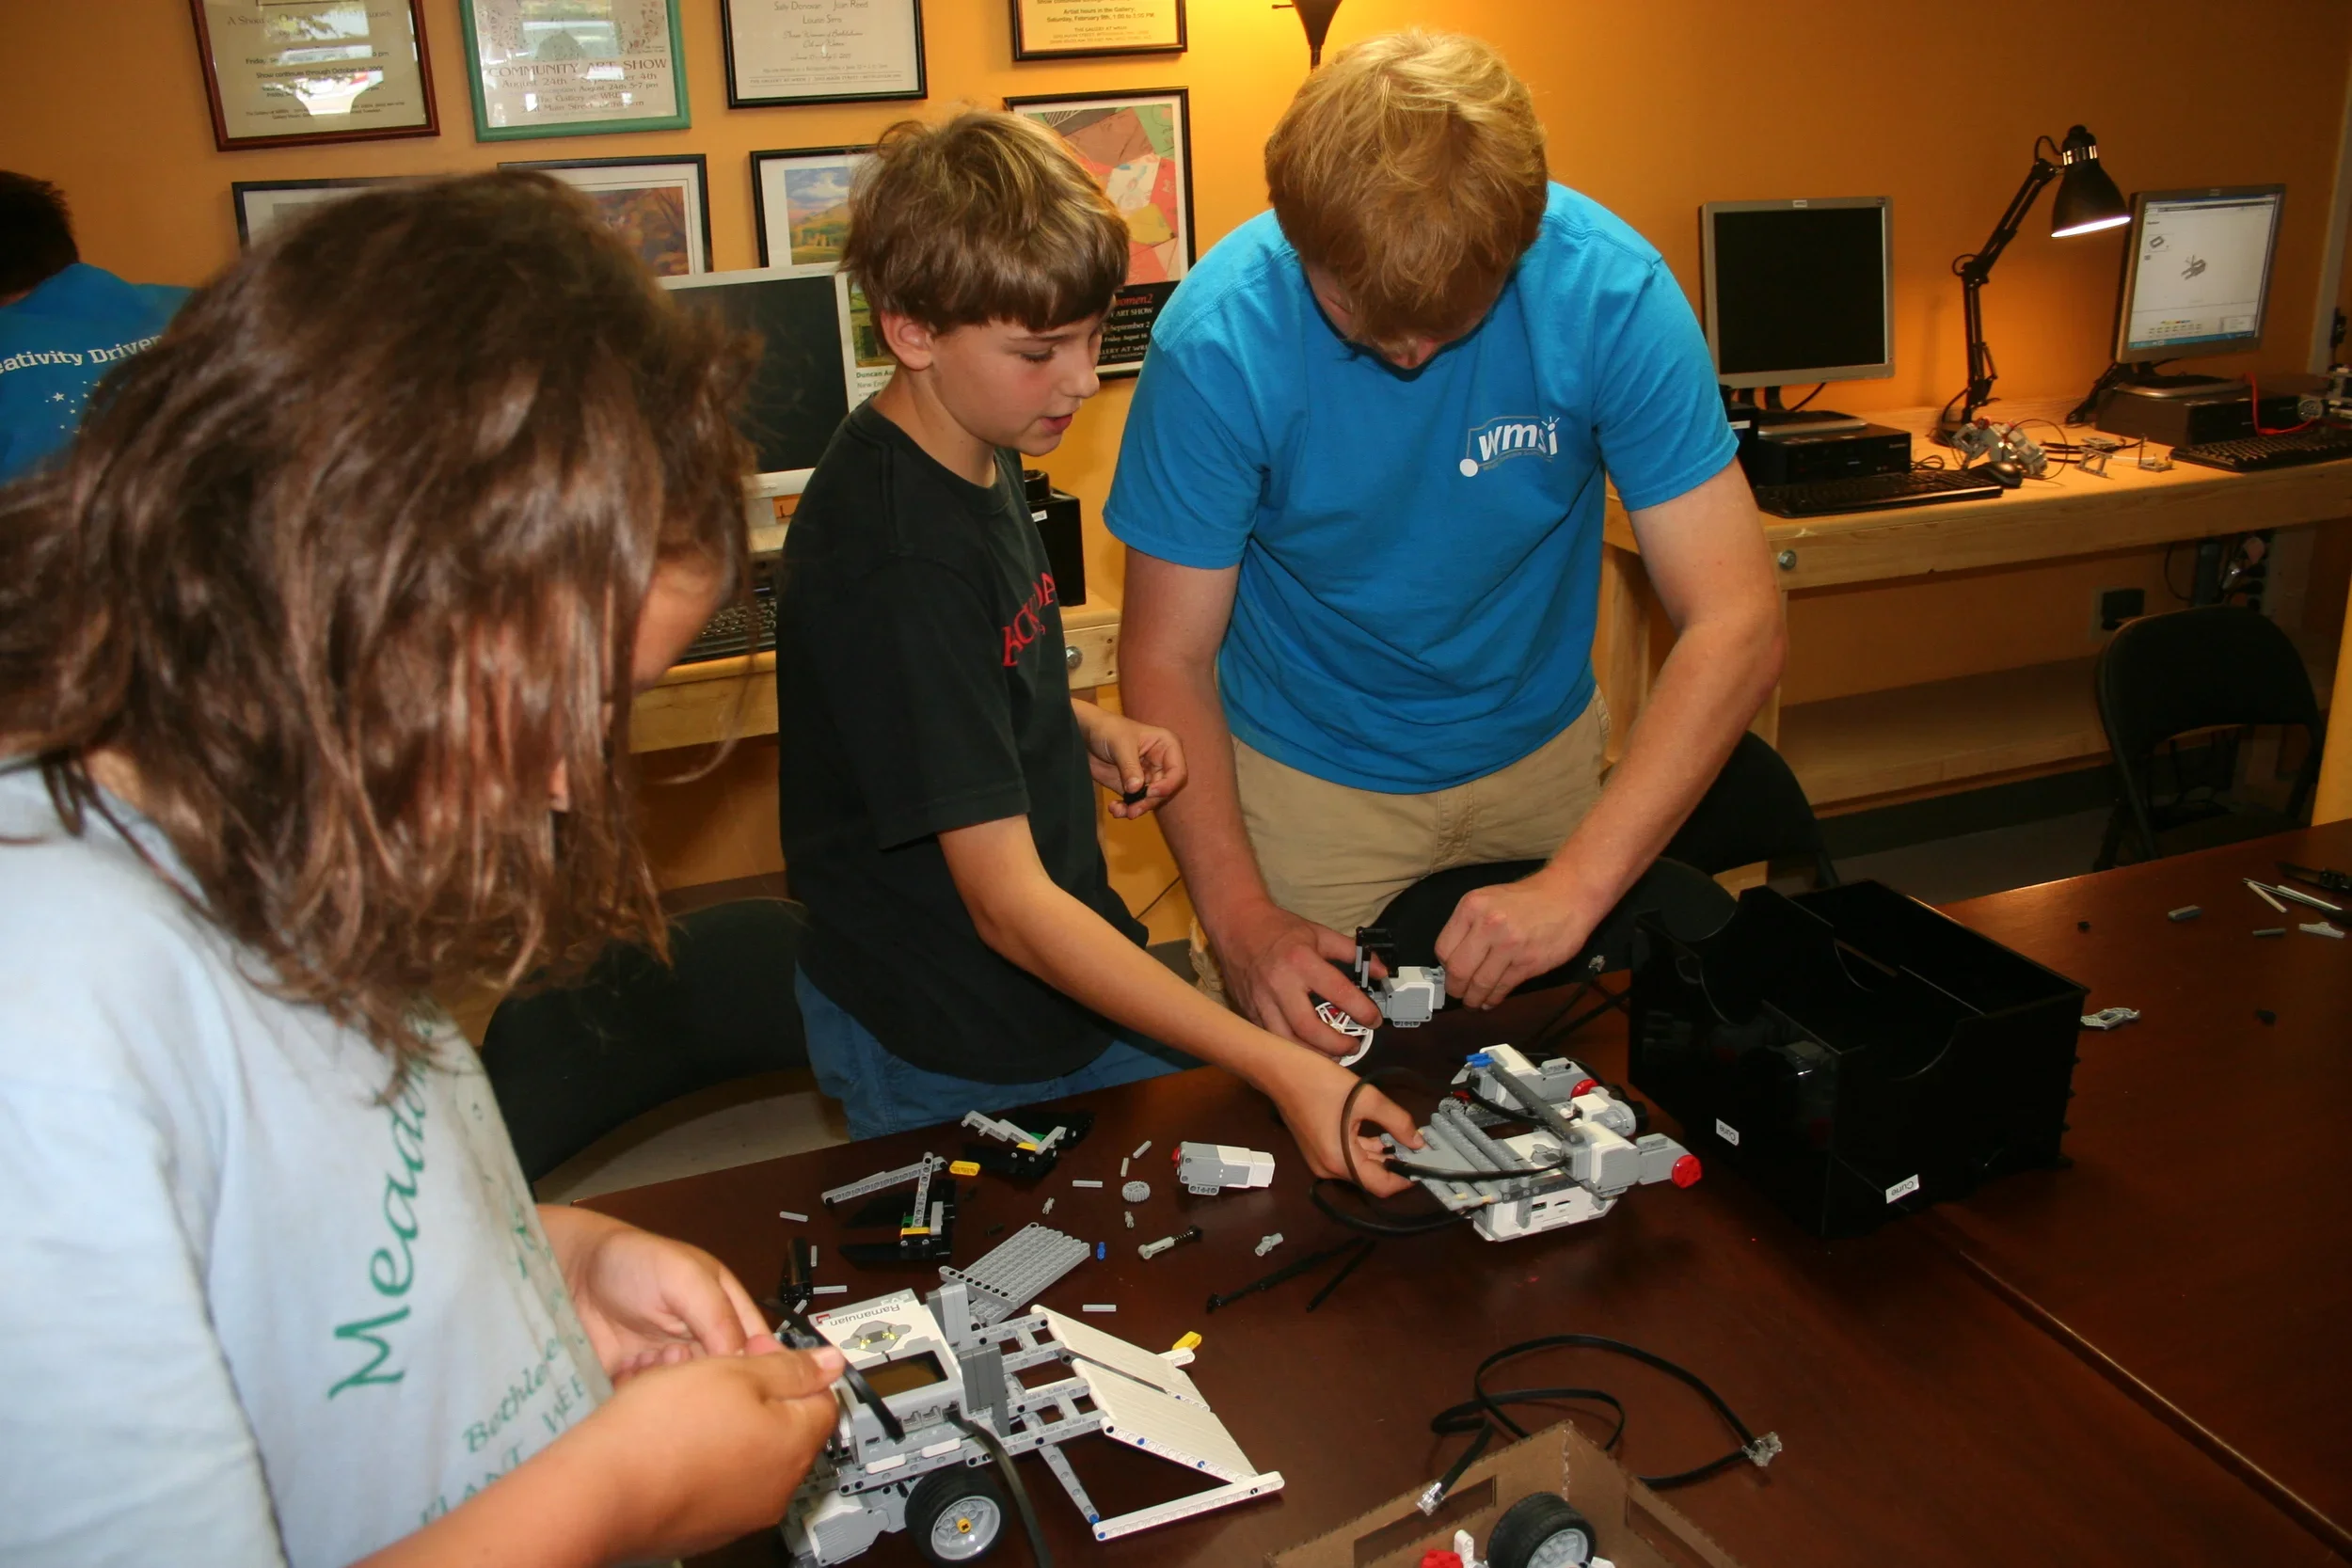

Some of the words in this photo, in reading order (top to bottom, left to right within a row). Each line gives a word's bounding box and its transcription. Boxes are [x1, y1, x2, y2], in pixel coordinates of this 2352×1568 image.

[488, 63, 579, 77] COMMUNITY
[623, 58, 667, 71] SHOW
[501, 79, 536, 90] August
[542, 77, 567, 87] 24th
[1116, 309, 1130, 317] ART
[1130, 307, 1153, 316] SHOW
[830, 1304, 900, 1326] Ramanujan
